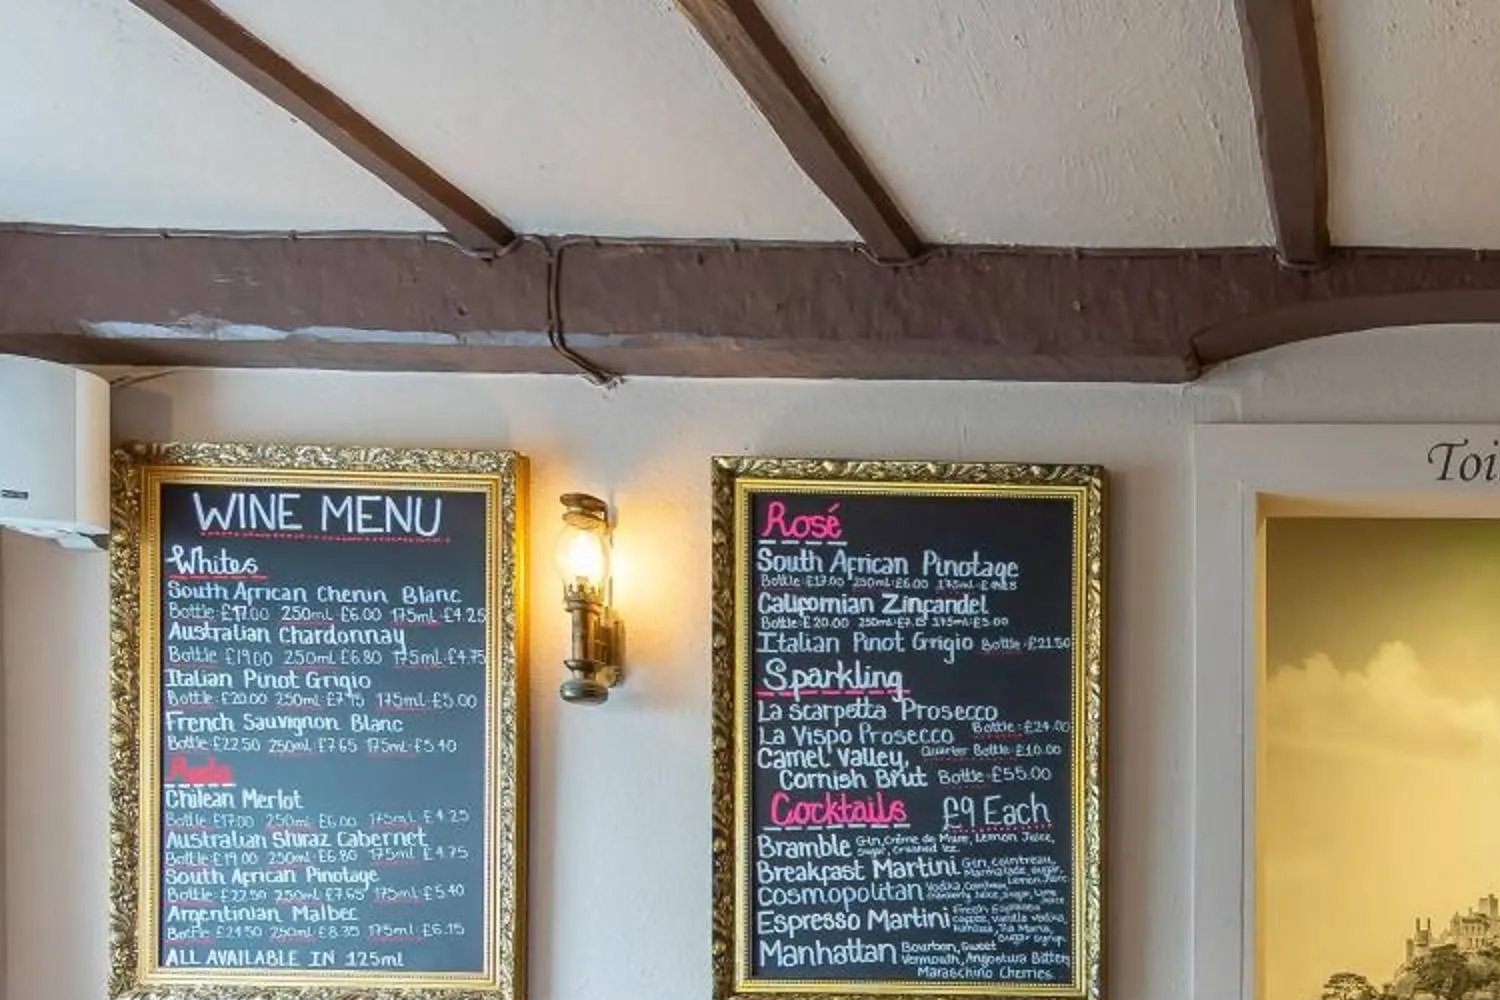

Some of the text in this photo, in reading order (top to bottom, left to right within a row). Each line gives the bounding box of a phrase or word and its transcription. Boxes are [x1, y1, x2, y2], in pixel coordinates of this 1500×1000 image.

[193, 492, 443, 537] WINE MENU
[761, 501, 844, 539] Rosé
[165, 544, 259, 575] Whites
[757, 547, 1020, 588] South African Pinotage
[167, 580, 463, 605] South African Chenin Blanc
[758, 591, 989, 621] Californian Zinfandel
[341, 607, 383, 623] £6.00
[168, 621, 407, 655] Australian Chardonnay
[756, 631, 840, 653] Italian
[853, 630, 905, 653] Pinot
[912, 631, 974, 664] Grigio
[165, 667, 372, 697] Italian Pinot Grigio
[762, 657, 904, 703] Sparkling
[165, 711, 404, 737] French Sauvignon Blanc
[758, 700, 783, 722] La
[900, 697, 998, 721] Prosecco
[759, 725, 785, 745] La
[791, 725, 853, 753] Vispo
[859, 721, 954, 745] Prosecco
[757, 746, 831, 769] Camel
[836, 747, 910, 776] Valley,
[779, 769, 868, 791] Cornish
[875, 766, 929, 789] Brut
[991, 765, 1053, 784] £55.00
[165, 788, 306, 810] Chilean Merlot
[770, 791, 1053, 831] Cocktails £9 Each
[166, 827, 430, 850] Australian Shiraz Cabernet
[757, 833, 853, 860] Bramble
[165, 865, 381, 891] South African Pinotage
[756, 855, 962, 886] Breakfast Martini
[757, 881, 925, 912] Cosmopolitan
[166, 904, 360, 928] Argentinian Malbec
[757, 909, 861, 938] Espresso
[867, 906, 951, 932] Martini
[165, 947, 406, 967] ALL AVAILABLE IN 125ml
[759, 937, 898, 968] Manhattan
